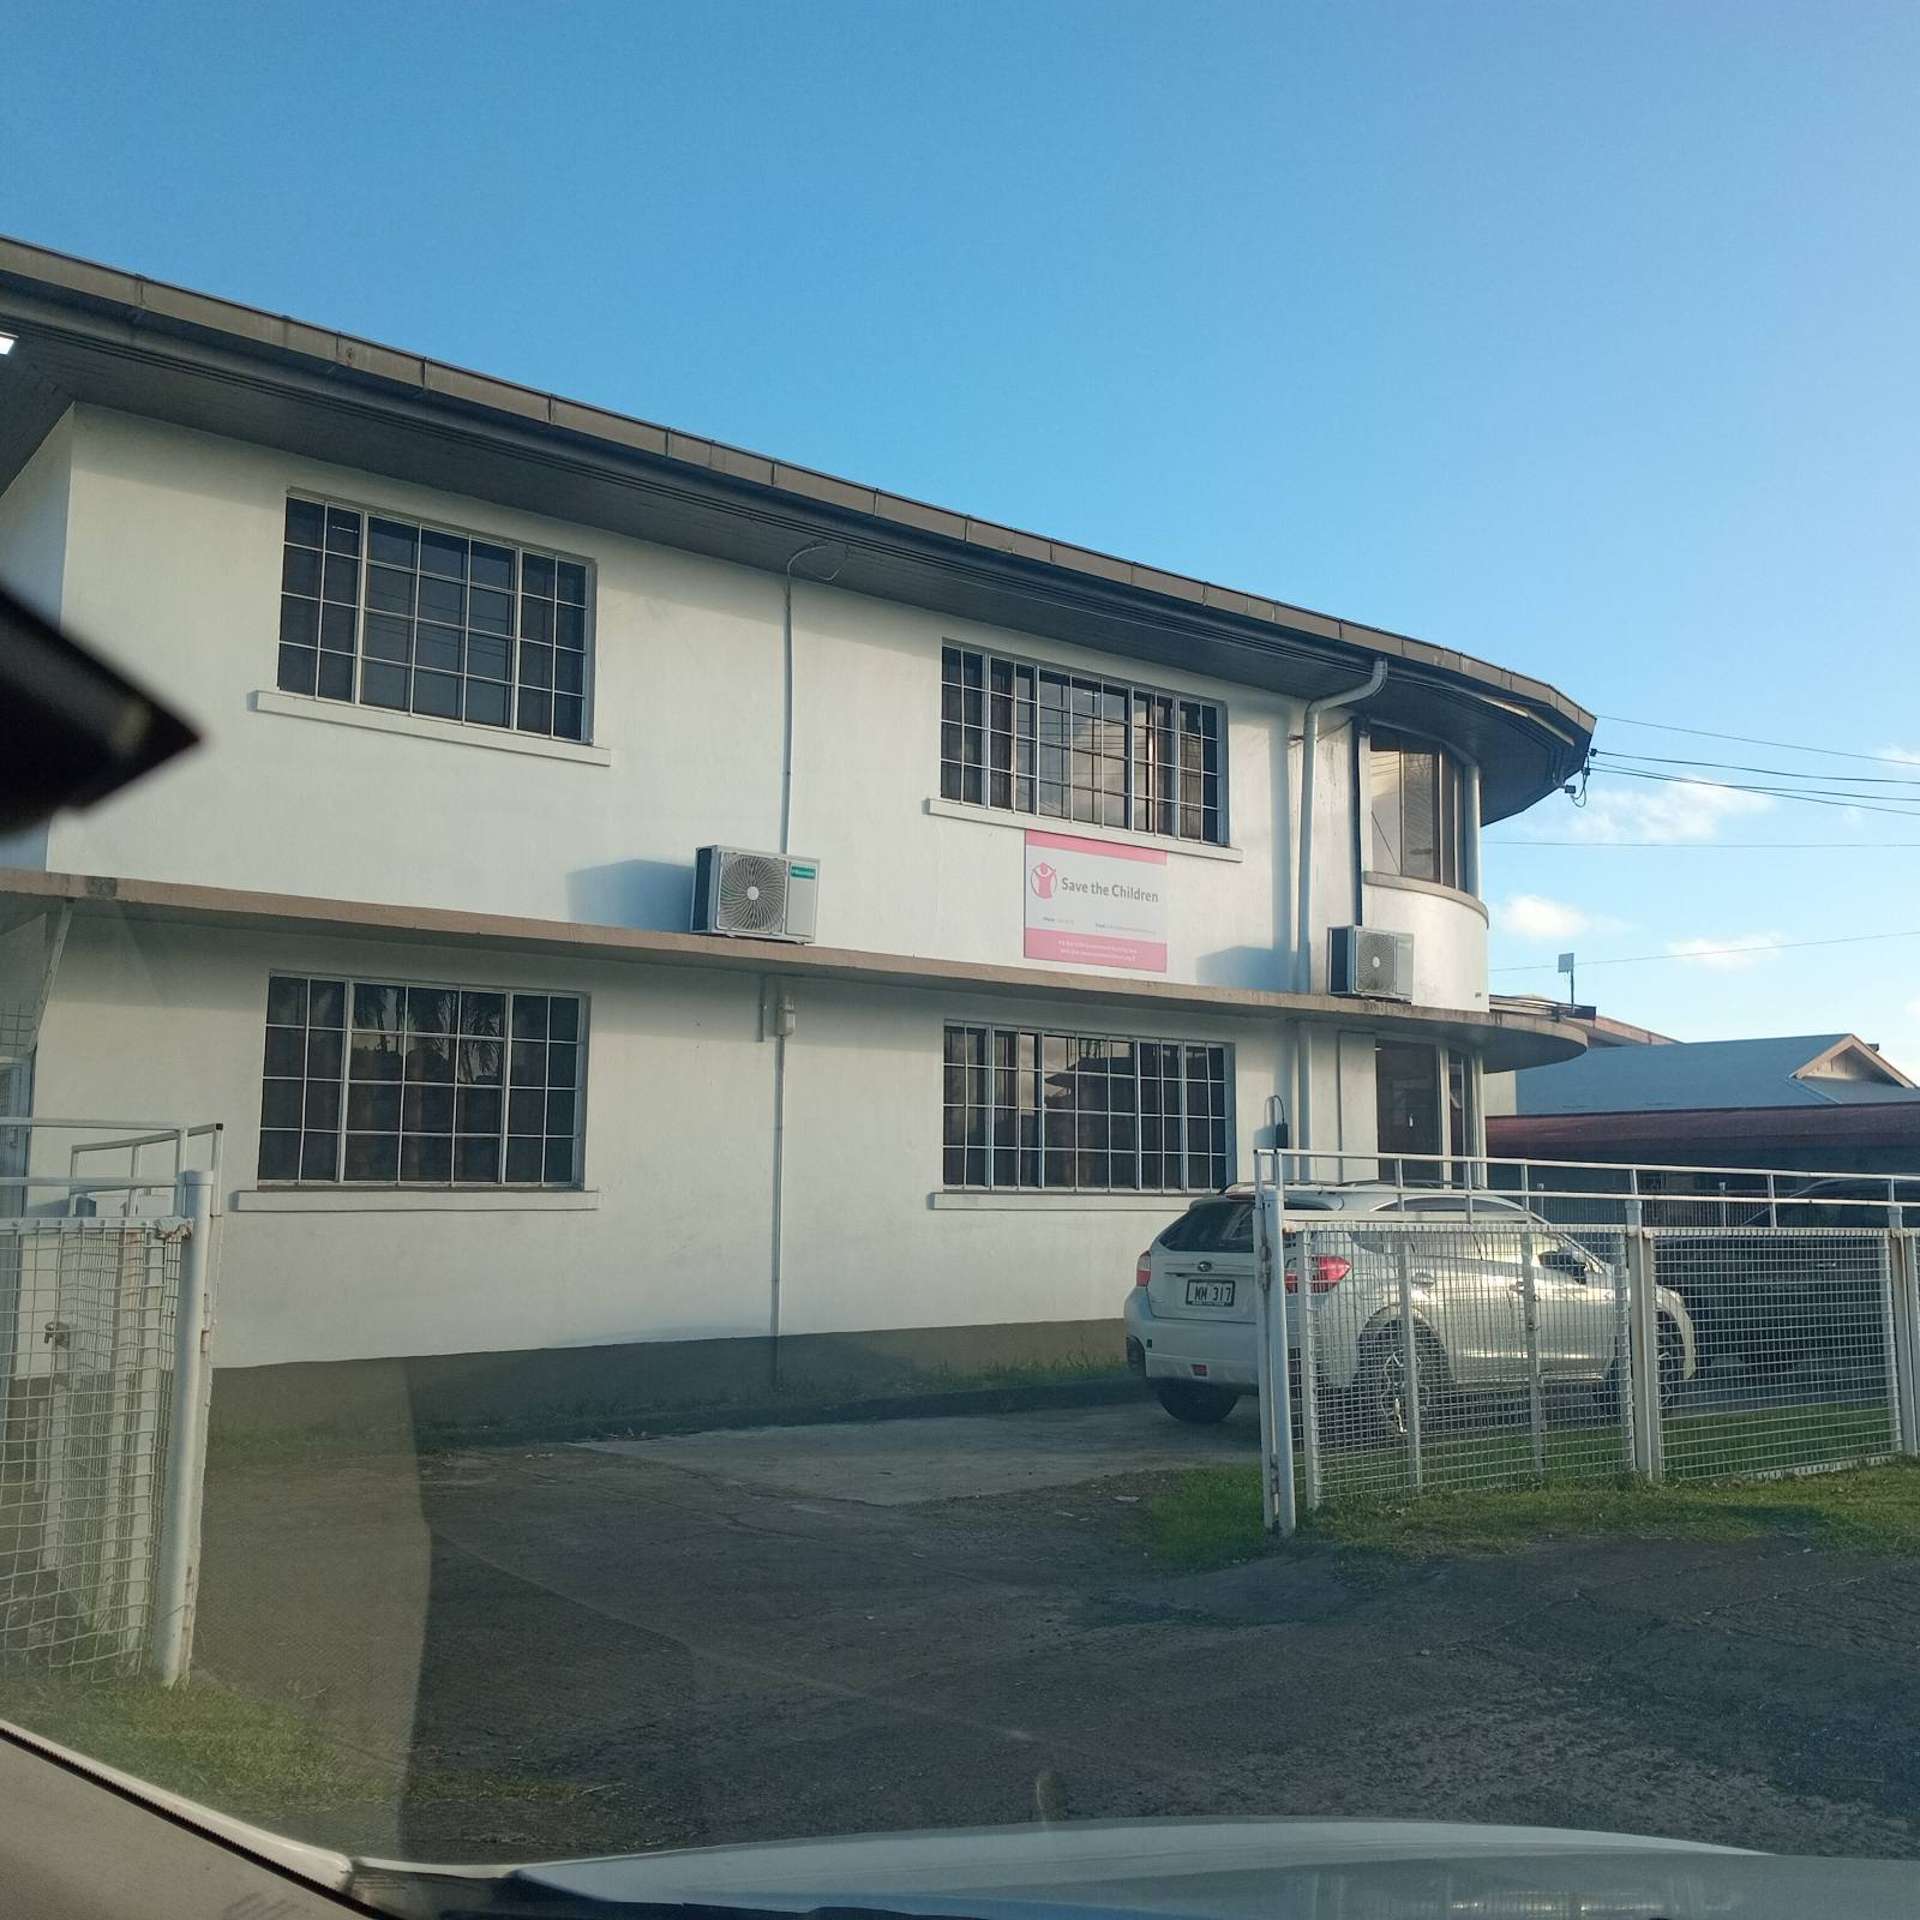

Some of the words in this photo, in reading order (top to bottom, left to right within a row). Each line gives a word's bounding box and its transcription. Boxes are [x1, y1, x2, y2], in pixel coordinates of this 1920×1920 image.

[1062, 877, 1088, 893] Save
[1091, 882, 1109, 896] the
[1112, 884, 1158, 902] Children
[1213, 1286, 1231, 1301] 317
